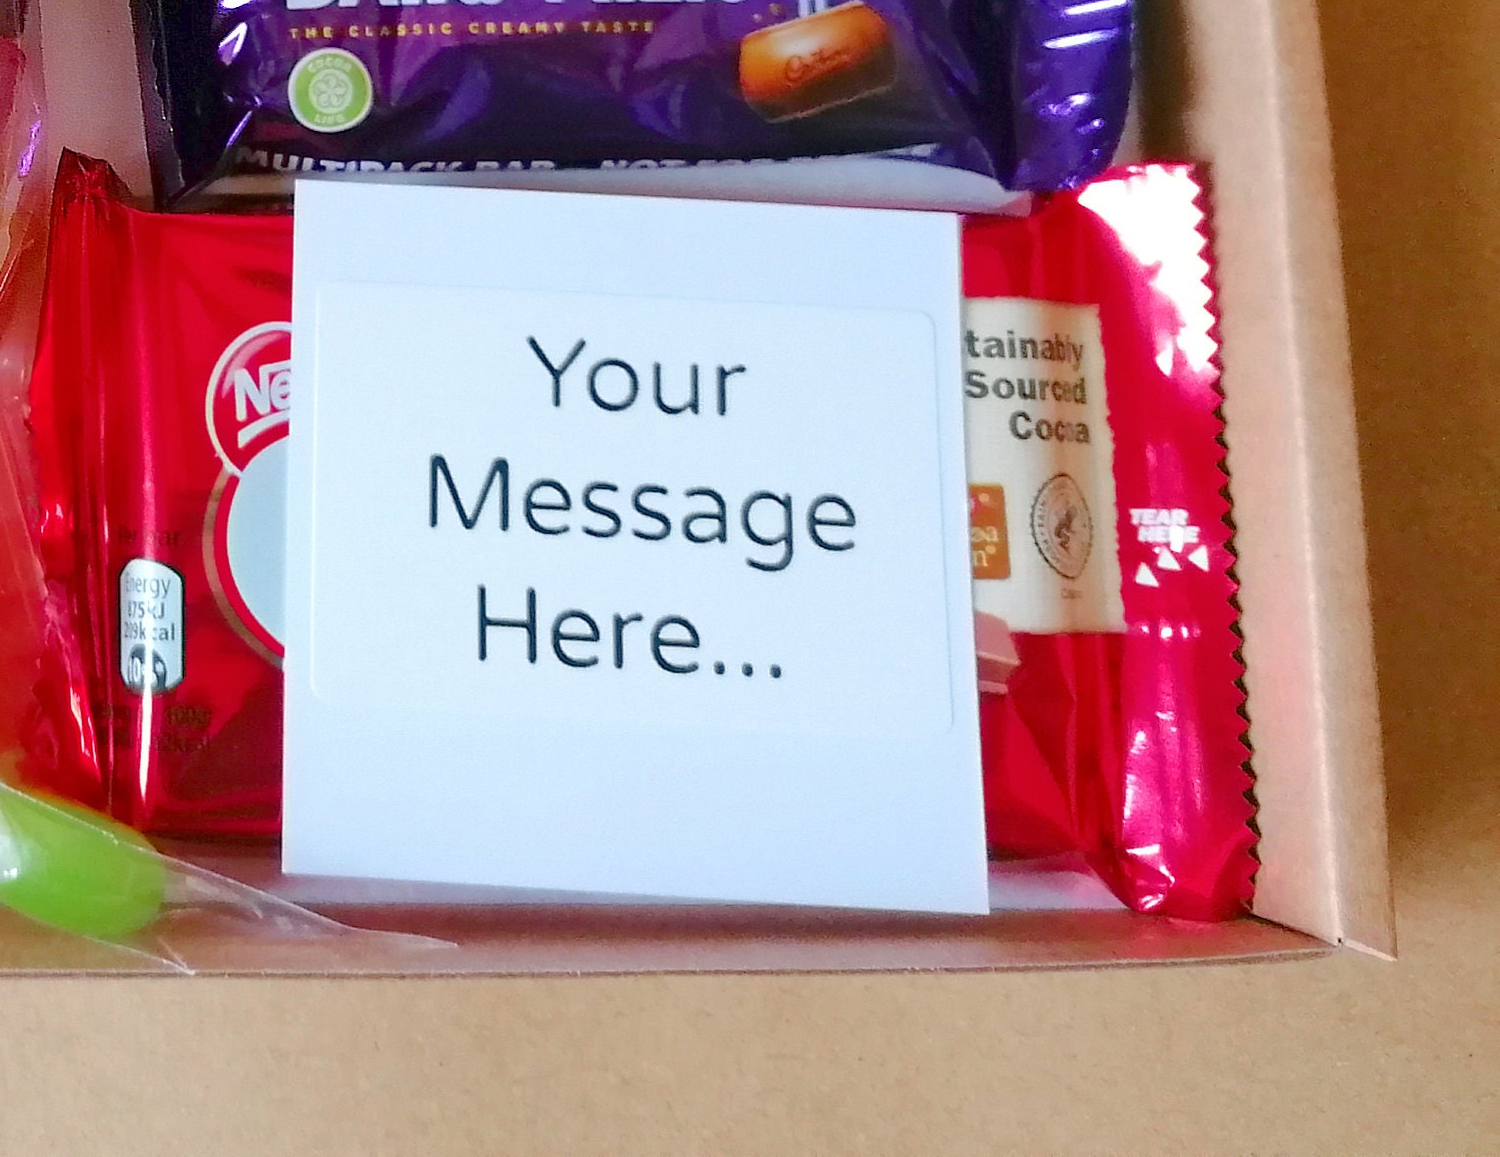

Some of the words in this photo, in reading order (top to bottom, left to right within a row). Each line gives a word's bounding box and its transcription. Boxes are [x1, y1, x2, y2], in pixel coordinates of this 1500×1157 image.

[289, 26, 334, 39] THE
[349, 23, 453, 37] CLASSIC
[468, 21, 566, 34] CREAMY
[581, 21, 655, 34] TASTE
[527, 335, 748, 416] Your
[428, 452, 857, 572] Message
[1137, 525, 1201, 544] HEE
[476, 584, 782, 679] Here...
